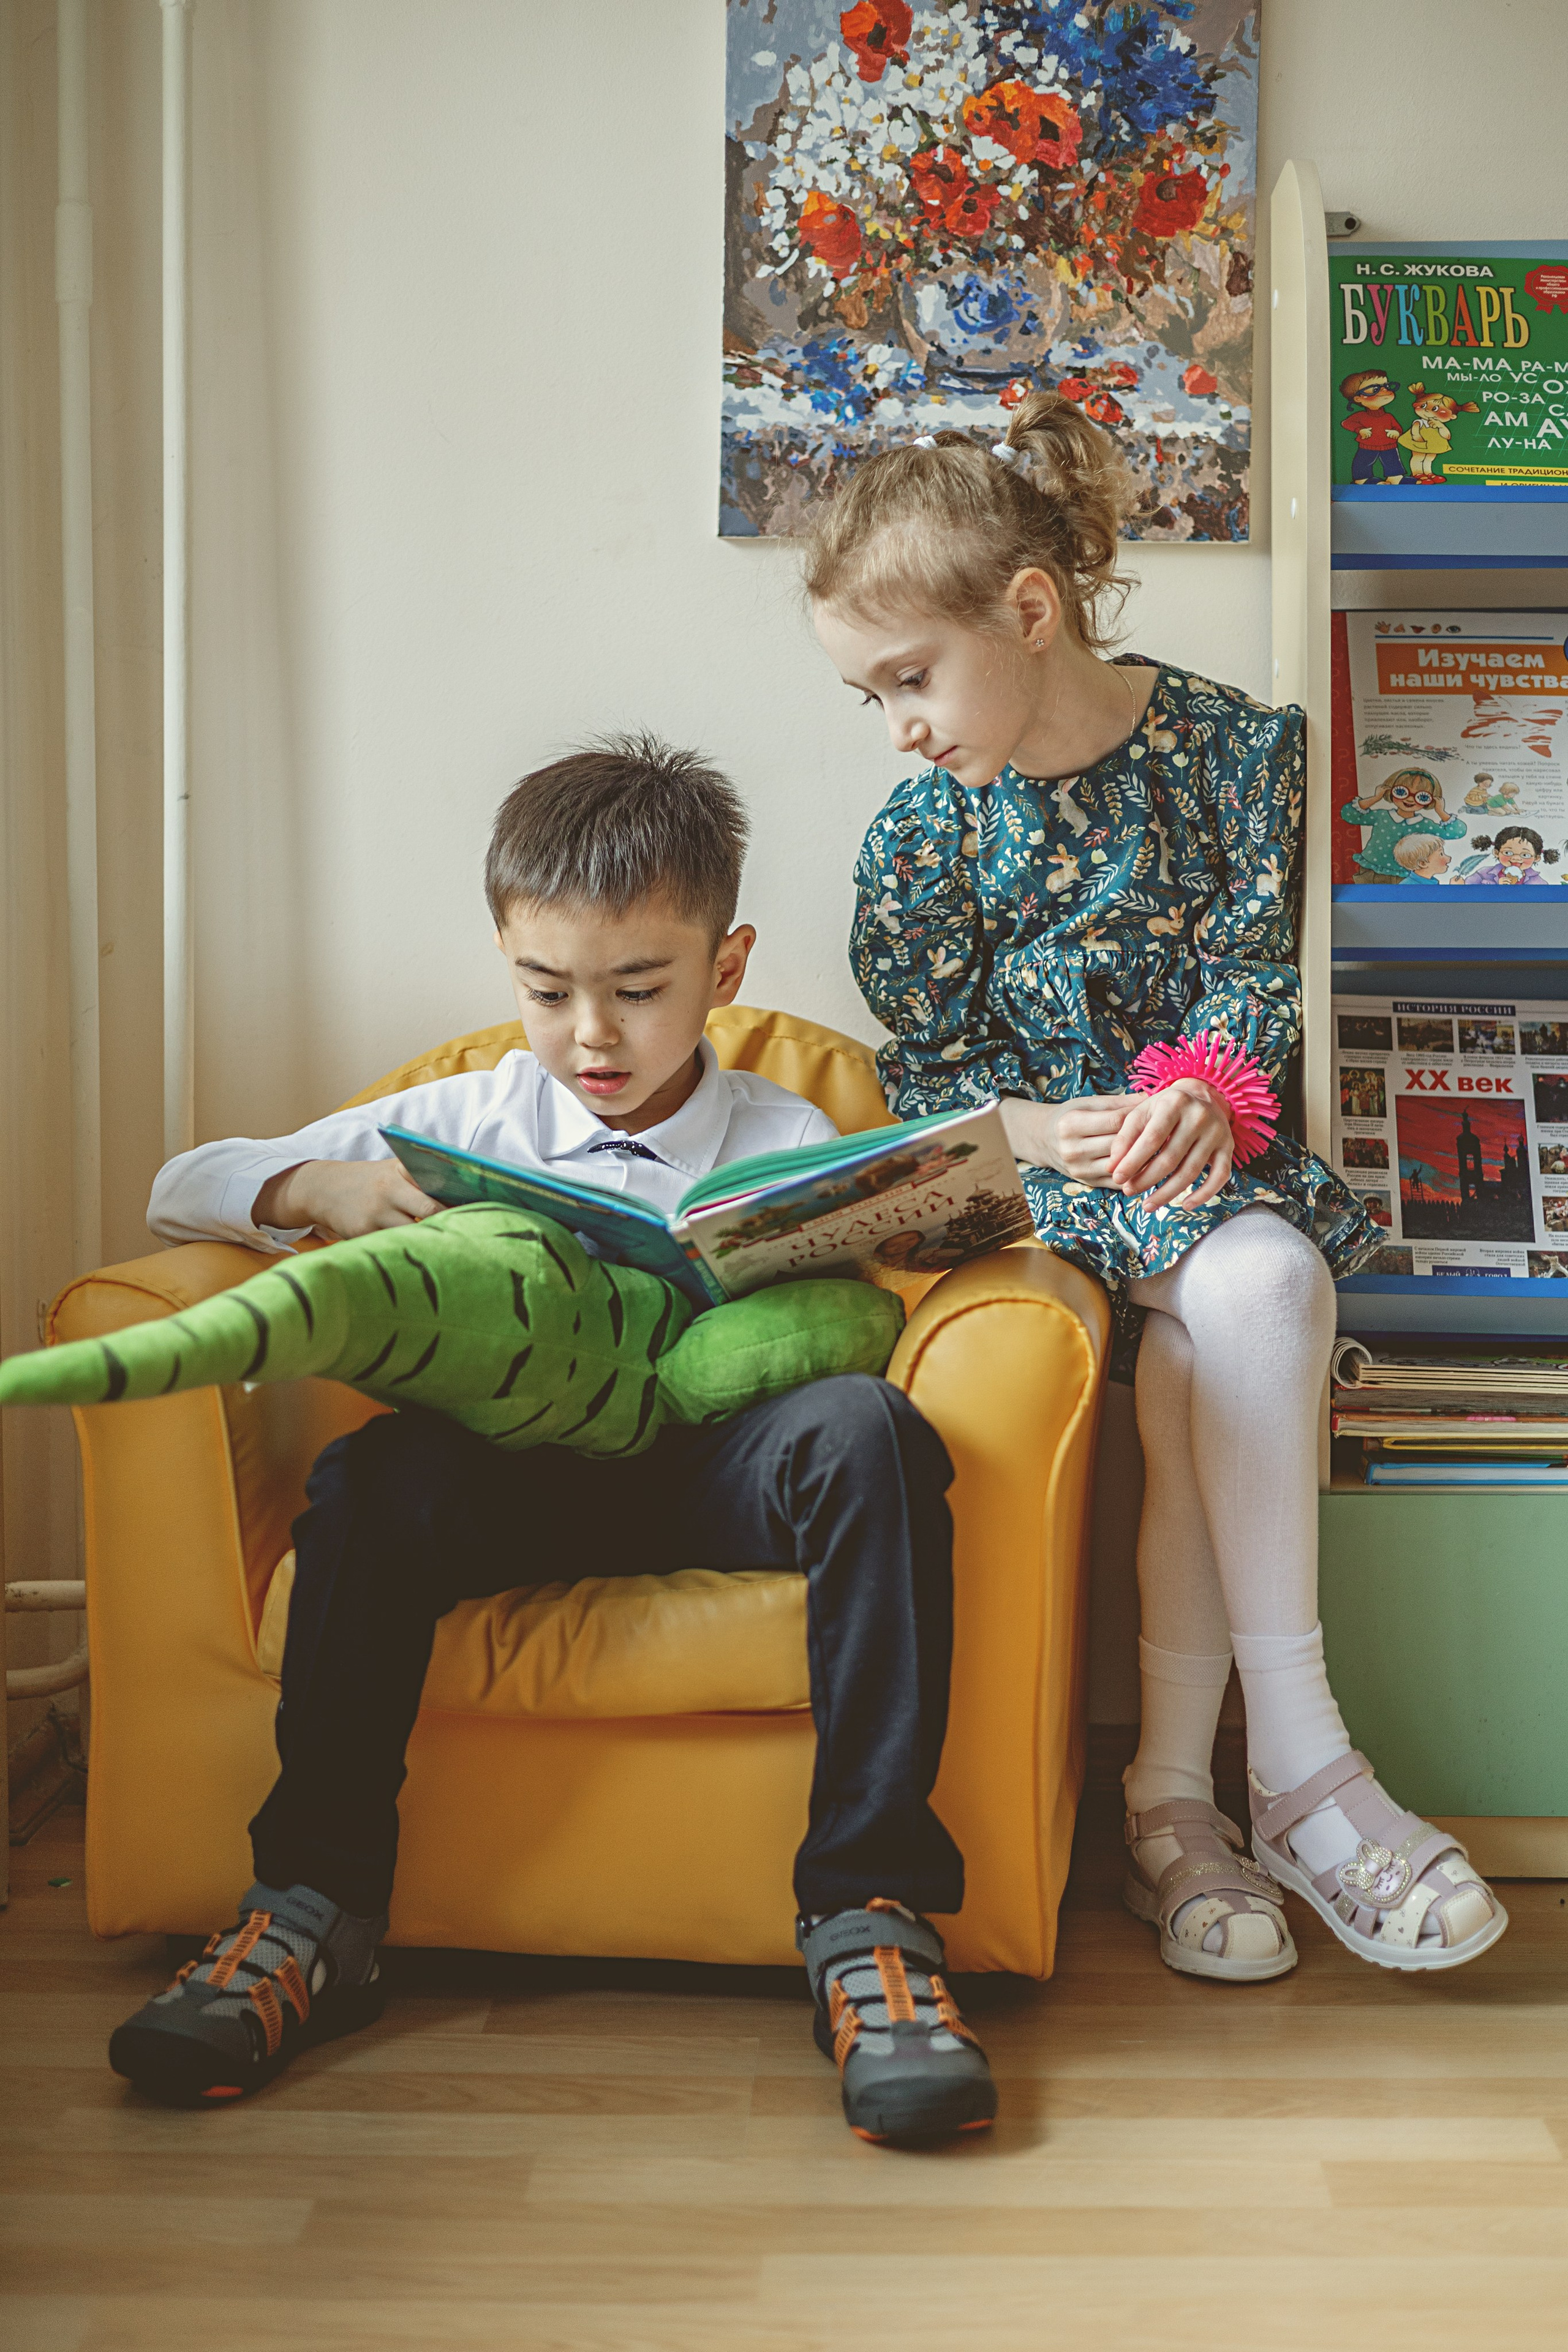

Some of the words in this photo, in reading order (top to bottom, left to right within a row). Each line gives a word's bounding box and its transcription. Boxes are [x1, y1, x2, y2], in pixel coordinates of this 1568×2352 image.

[1357, 263, 1375, 275] Н.
[1380, 264, 1400, 276] С.
[1404, 265, 1494, 277] ЖУКОВА
[1340, 283, 1529, 349] БУКВАРЬ
[1422, 356, 1512, 371] МА-МА
[1447, 372, 1501, 382] МЫ-ЛО
[1510, 372, 1538, 383] УС
[1542, 379, 1568, 394] О
[1482, 391, 1545, 404] РО-ЗА
[1548, 404, 1568, 417] С
[1483, 411, 1528, 427] АМ
[1487, 437, 1552, 450] ЛУ-НА
[1418, 648, 1545, 671] Изучаем
[1390, 673, 1463, 688] наши
[1397, 1003, 1457, 1014] ИСТОРИЯ
[1461, 1005, 1512, 1014] РОССИИ
[1458, 1077, 1513, 1093] век
[792, 1191, 943, 1250] ЧУДЕСА
[789, 1196, 954, 1267] РОССИИ
[829, 1926, 870, 1941] GEOX
